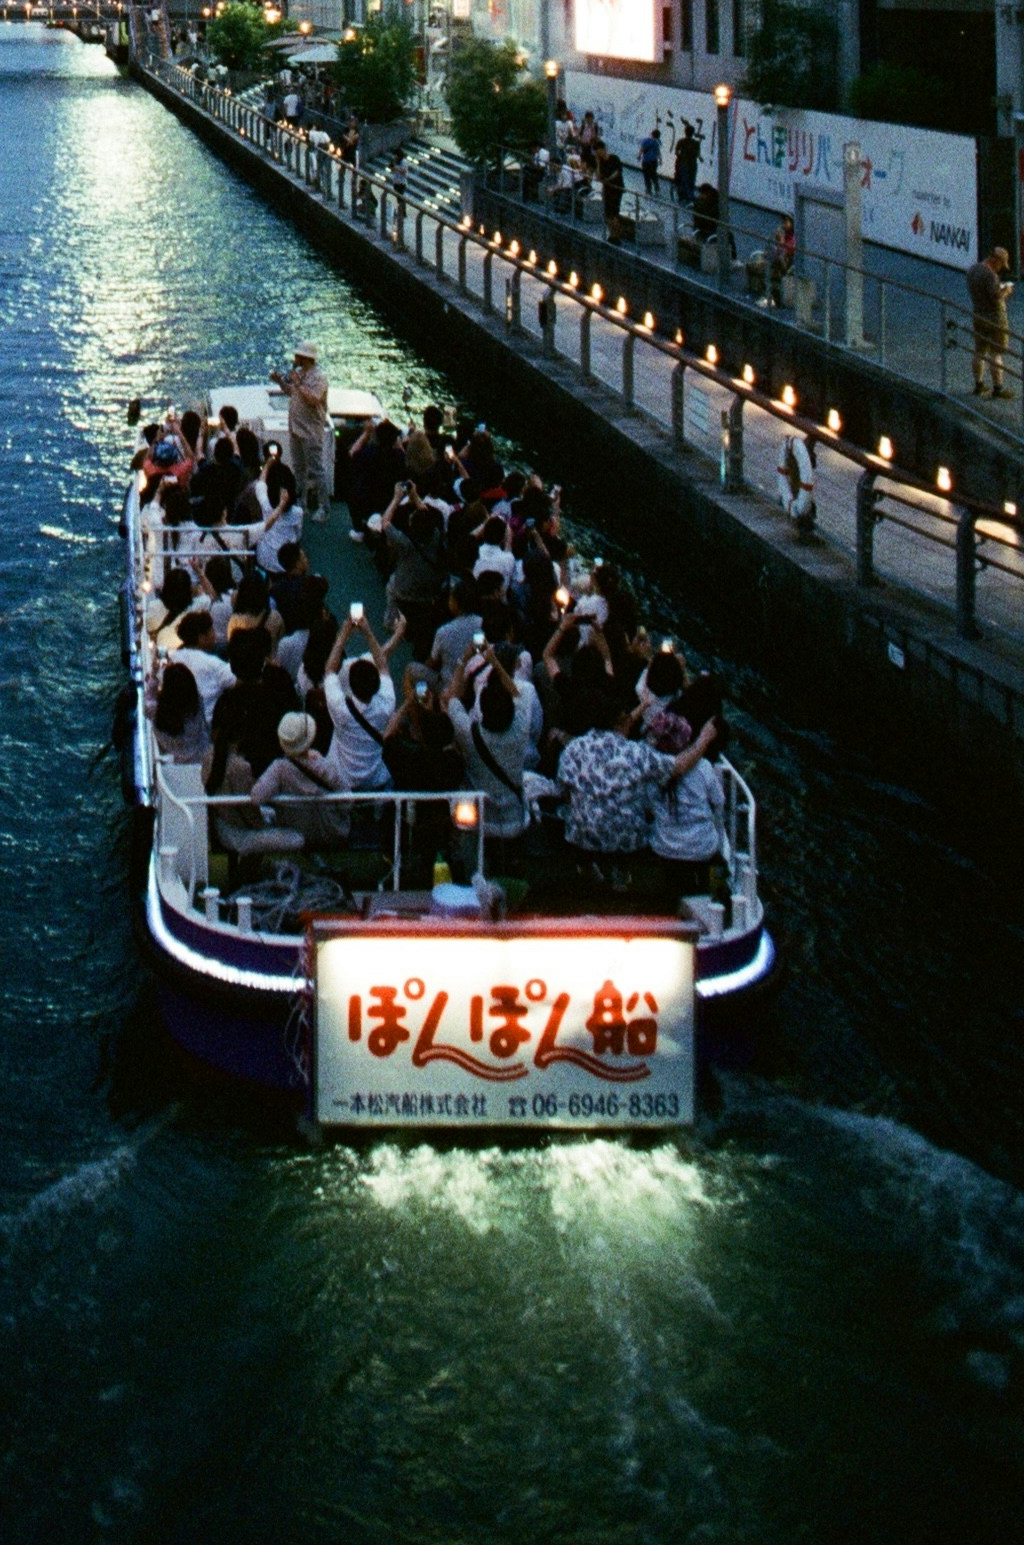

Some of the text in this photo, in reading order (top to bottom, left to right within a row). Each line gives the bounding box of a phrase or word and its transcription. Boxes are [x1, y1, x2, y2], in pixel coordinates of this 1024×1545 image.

[930, 220, 971, 253] NANKAI
[347, 977, 659, 1083] ぽんぽん船
[332, 1092, 680, 1117] 一本松汽船株式会社 06-6946-8363
